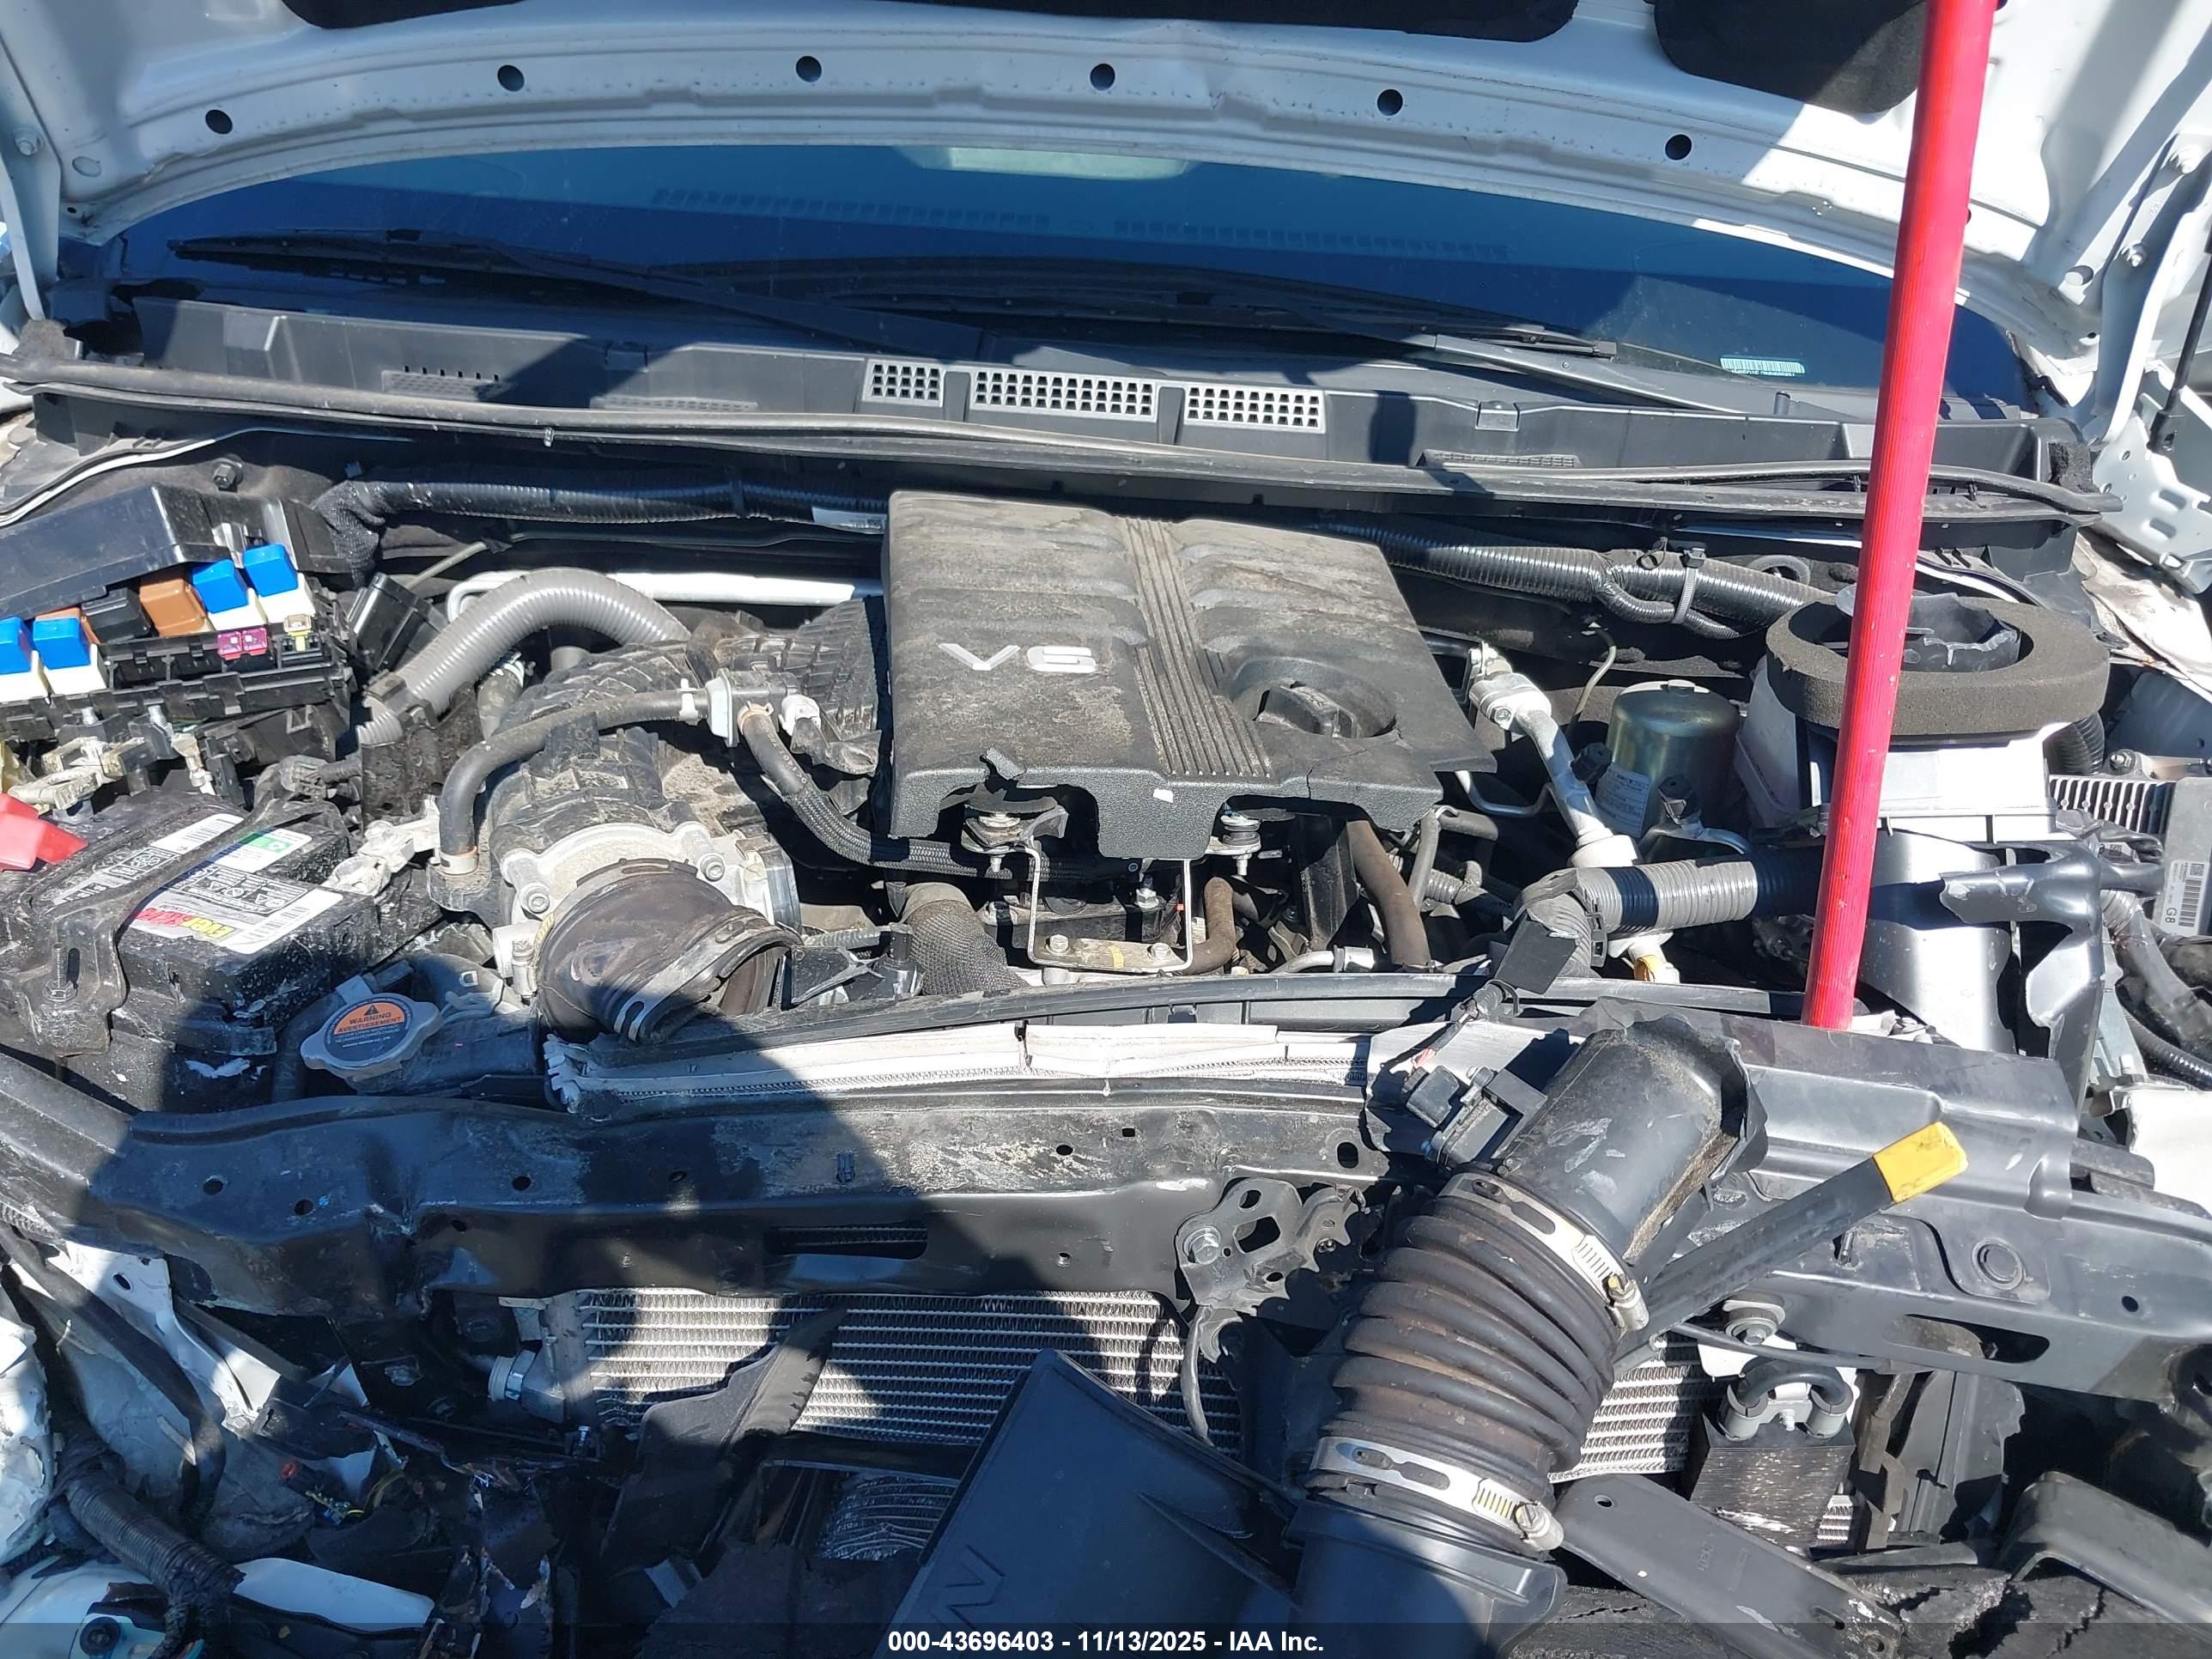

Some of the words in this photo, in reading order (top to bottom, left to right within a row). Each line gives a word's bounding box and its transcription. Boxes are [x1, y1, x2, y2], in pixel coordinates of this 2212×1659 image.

[938, 643, 1097, 673] V6
[2165, 907, 2177, 923] G8
[338, 1017, 401, 1032] AVERTISSEMENT
[349, 1012, 392, 1024] WARNING
